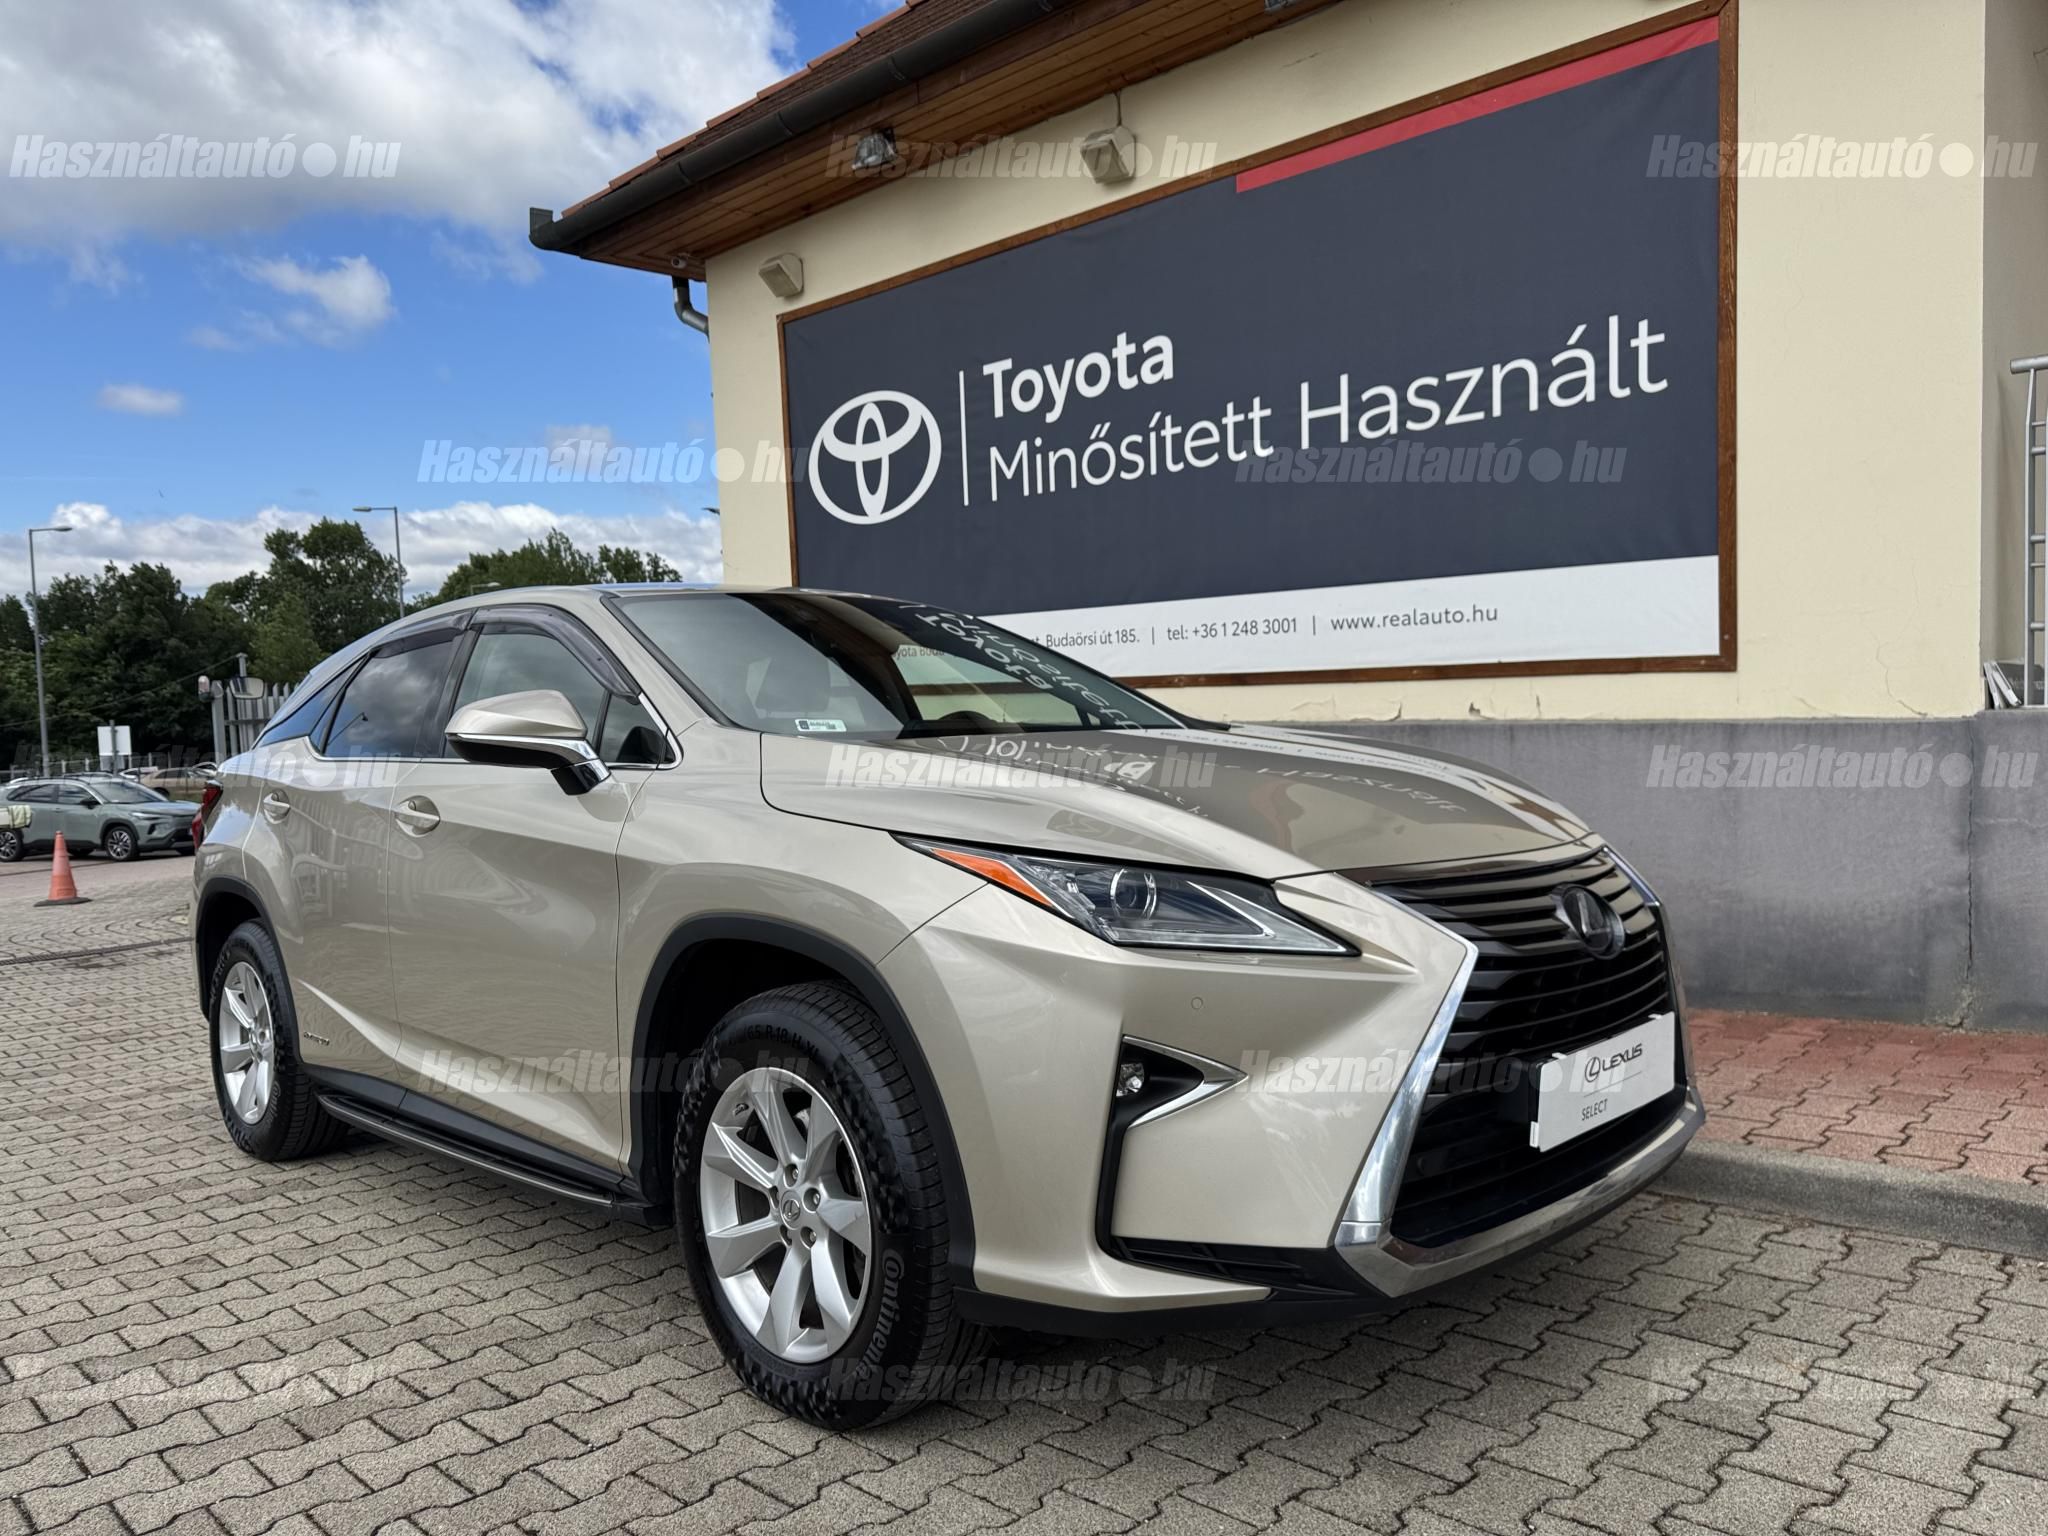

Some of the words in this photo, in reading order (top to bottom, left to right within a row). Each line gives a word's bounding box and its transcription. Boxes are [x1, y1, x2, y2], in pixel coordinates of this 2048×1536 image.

[982, 331, 1175, 422] Toyota
[990, 395, 1274, 500] Minősített
[1300, 314, 1669, 449] Használt
[1167, 624, 1188, 641] tel:
[1192, 622, 1218, 639] +36
[1232, 620, 1258, 637] 248
[1263, 617, 1298, 635] 3001
[1330, 604, 1498, 630] www.realauto.hu
[1046, 632, 1096, 648] Budaörsi
[1100, 630, 1112, 644] út
[1115, 628, 1140, 643] 185.
[1603, 1043, 1643, 1072] LEXUS
[1581, 1098, 1607, 1121] SELECT
